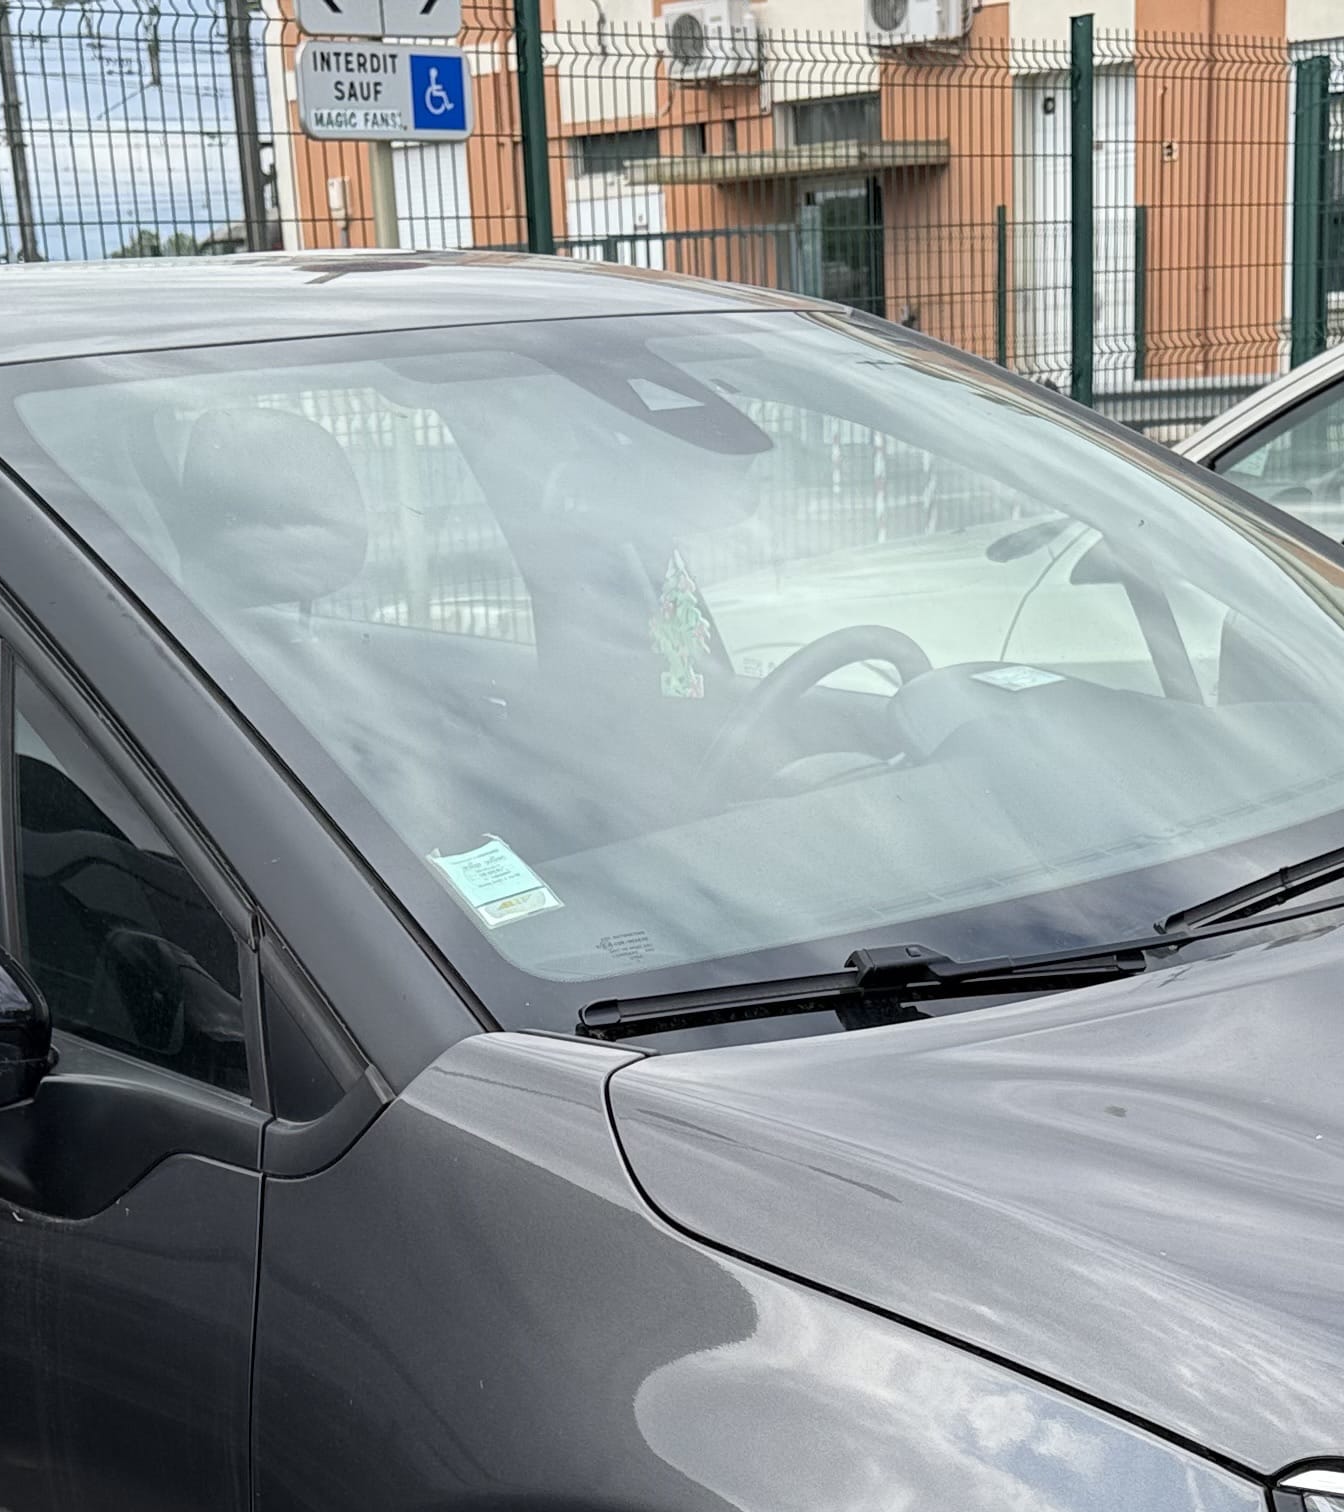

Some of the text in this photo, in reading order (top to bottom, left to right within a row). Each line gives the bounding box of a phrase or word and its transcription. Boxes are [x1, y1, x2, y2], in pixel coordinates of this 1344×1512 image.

[312, 50, 398, 75] INTERDIT
[334, 80, 383, 102] SAUF
[314, 112, 357, 129] MAGIC
